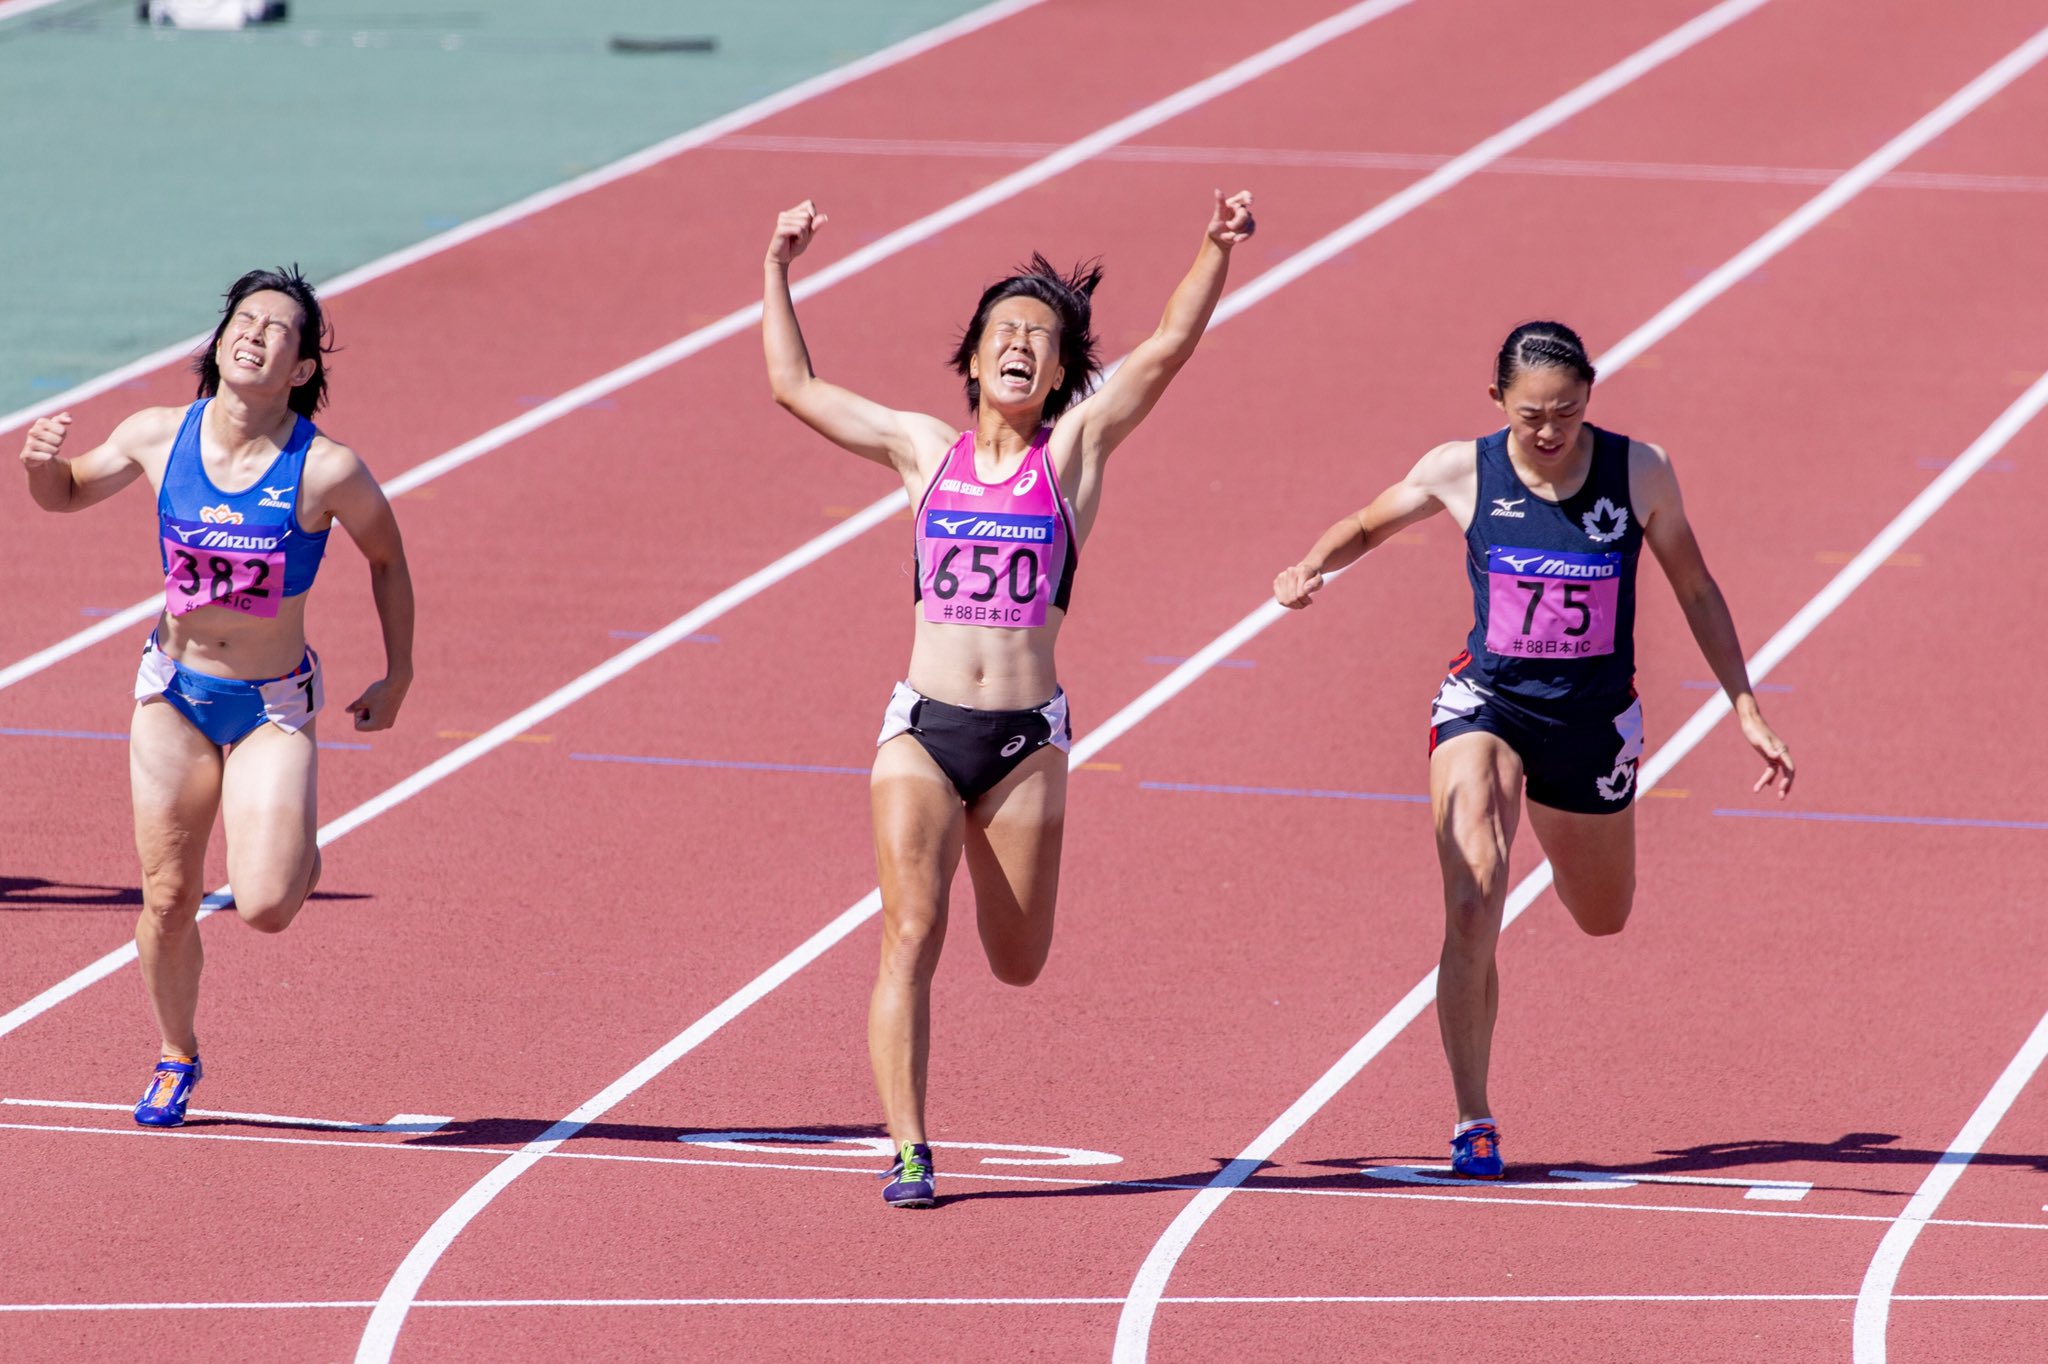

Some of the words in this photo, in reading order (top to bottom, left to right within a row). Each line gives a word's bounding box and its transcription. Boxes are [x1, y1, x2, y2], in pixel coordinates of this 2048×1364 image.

[175, 549, 270, 598] 382
[933, 545, 1039, 604] 650
[943, 604, 1021, 622] #88日本IC
[1516, 580, 1591, 637] 75
[1512, 638, 1591, 654] #88日本IC
